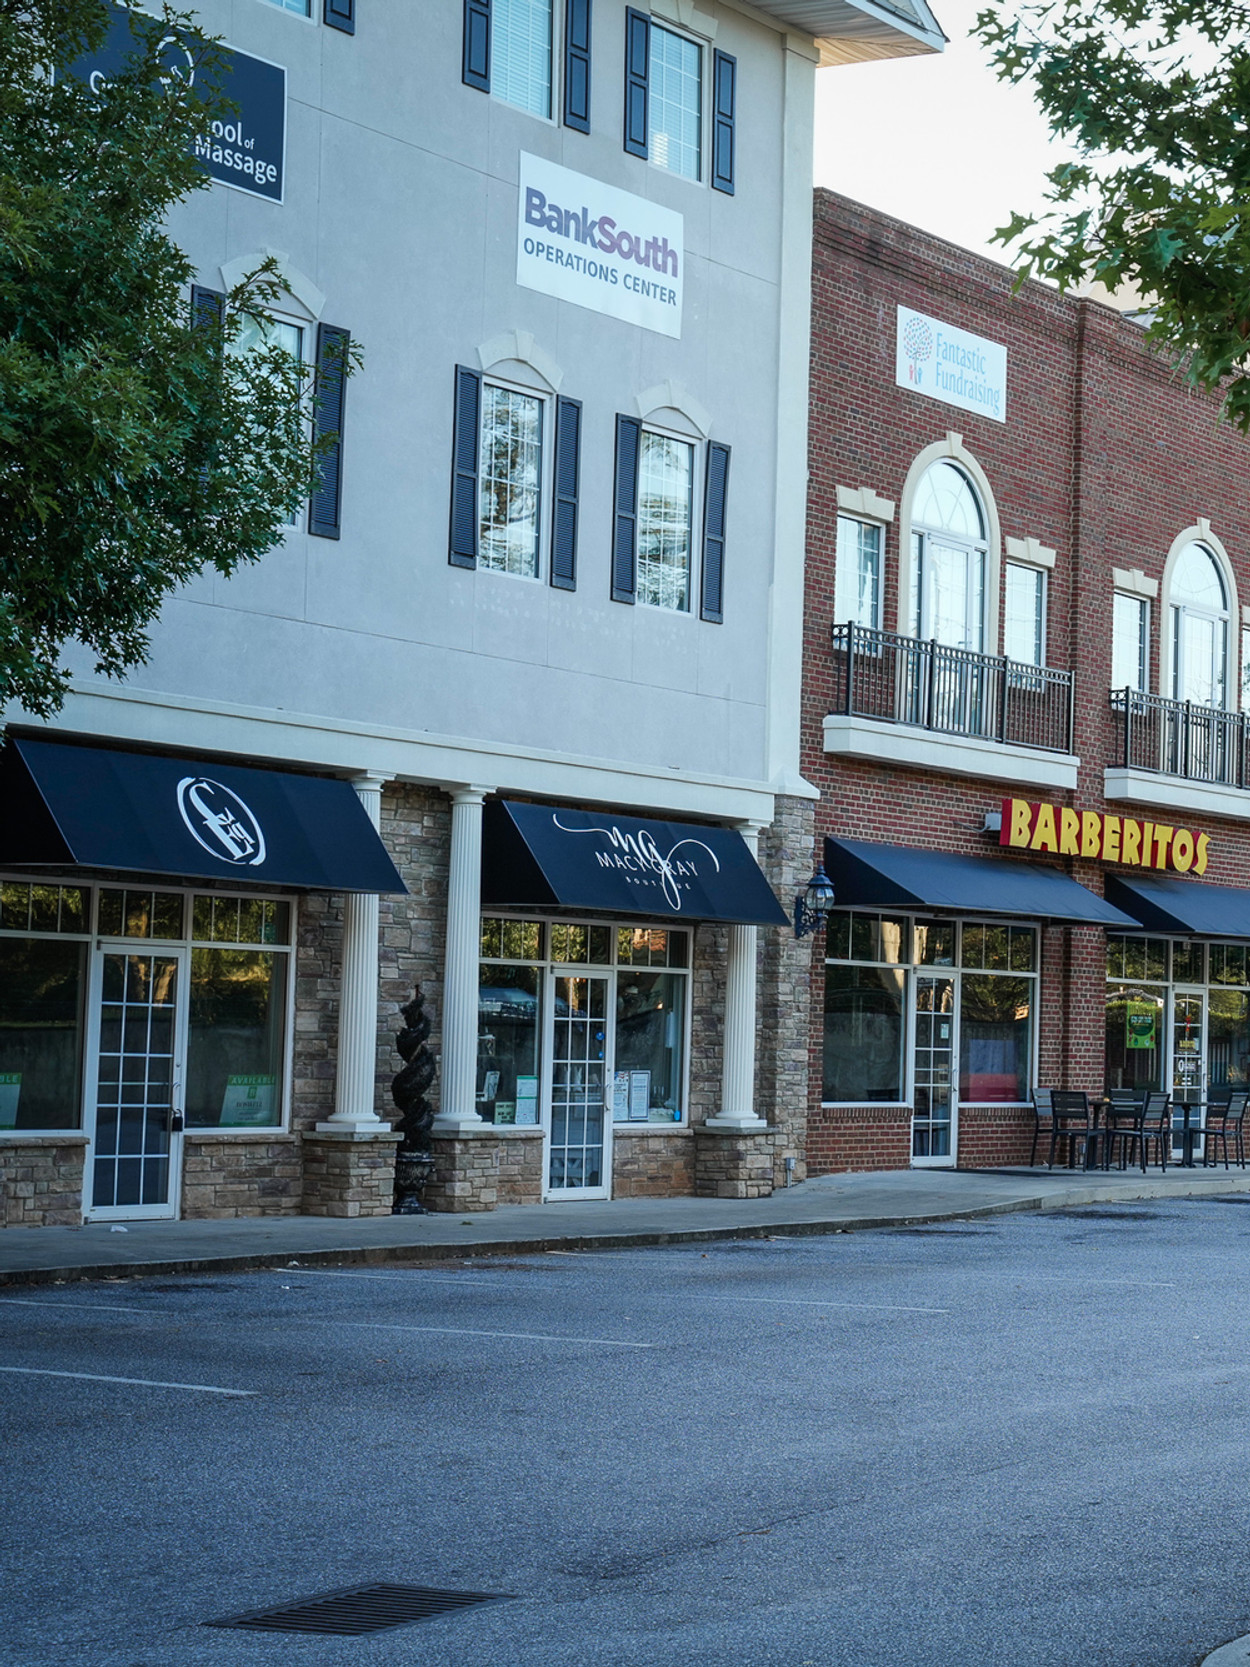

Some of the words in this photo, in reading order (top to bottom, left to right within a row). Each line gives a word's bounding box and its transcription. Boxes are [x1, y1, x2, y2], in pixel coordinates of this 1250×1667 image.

[195, 134, 277, 185] Massage
[244, 138, 255, 150] of
[525, 186, 678, 278] BankSouth
[523, 237, 619, 285] OPERATIONS
[623, 273, 677, 306] CENTER
[936, 332, 986, 375] Fantastic
[935, 361, 1000, 416] Fundraising
[1008, 798, 1212, 876] BARBERITOS
